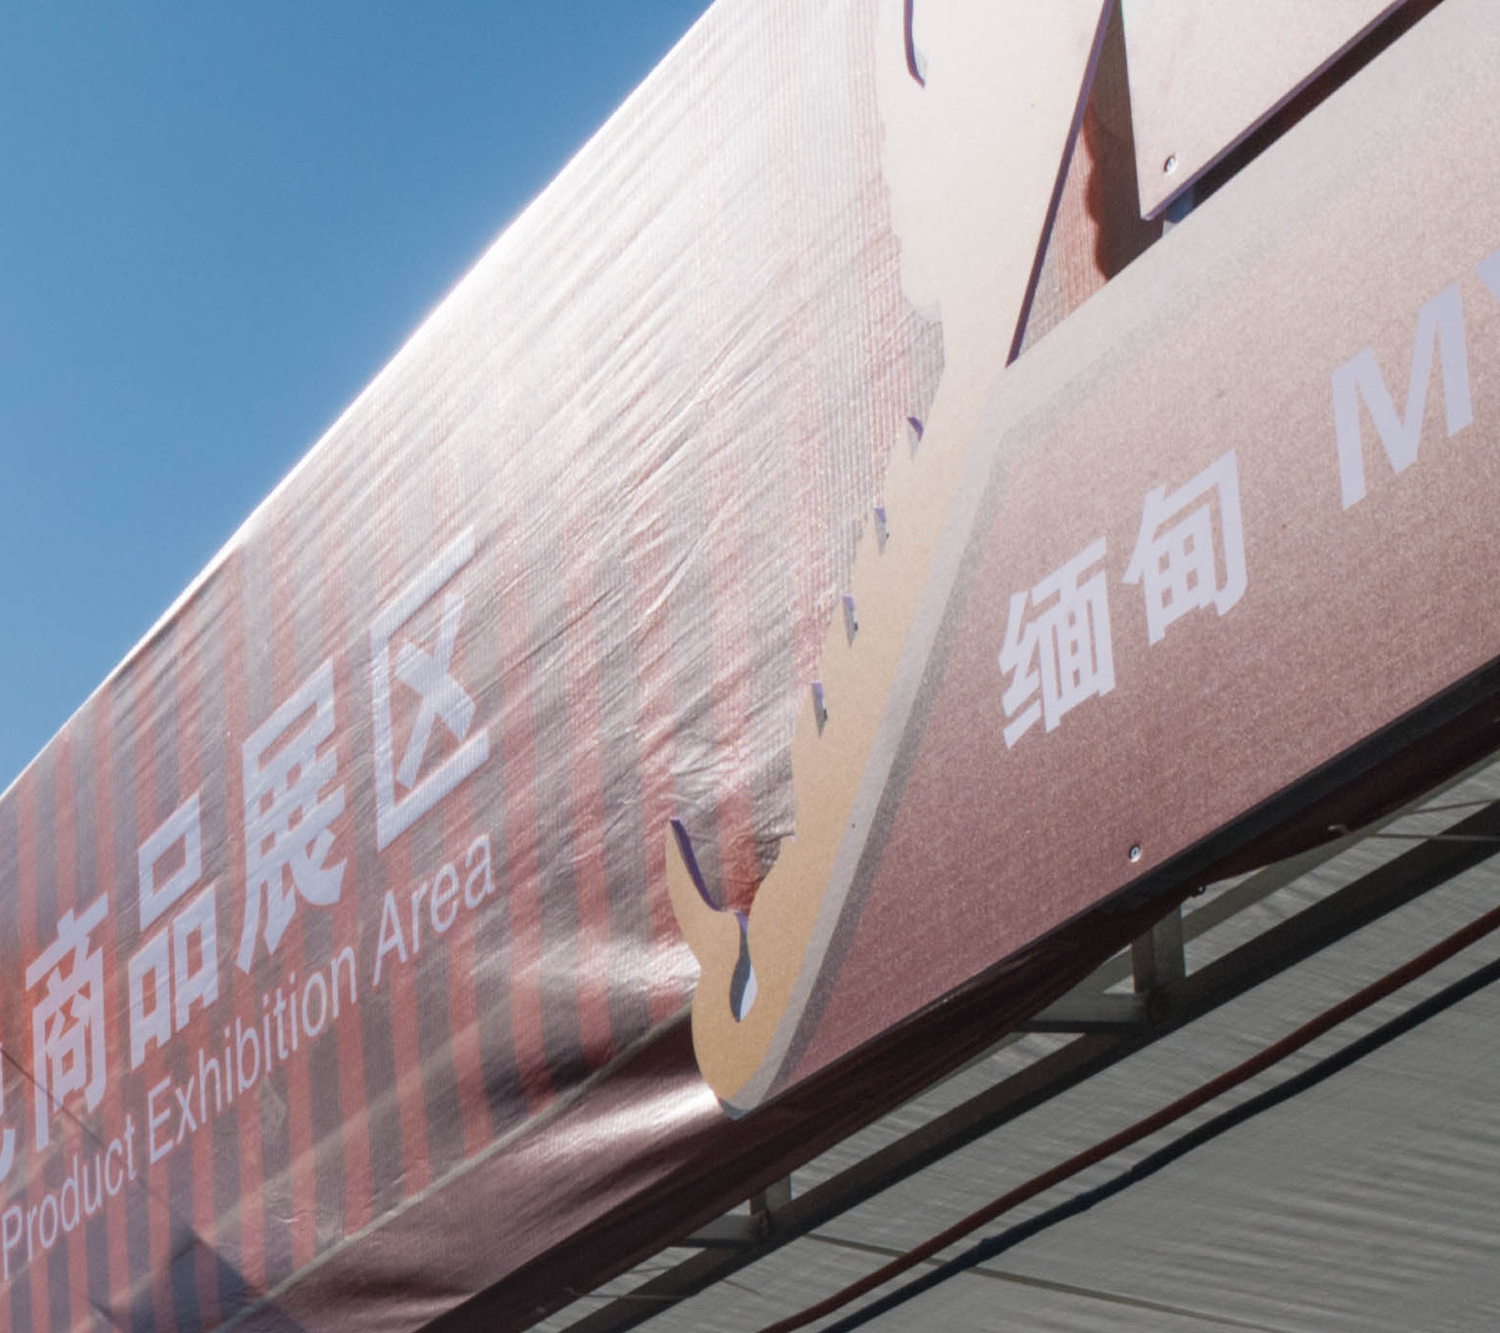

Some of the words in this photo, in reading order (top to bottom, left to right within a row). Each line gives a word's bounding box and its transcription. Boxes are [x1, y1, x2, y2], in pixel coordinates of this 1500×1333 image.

[1000, 451, 1248, 748] 缅甸
[1331, 250, 1500, 508] M
[3, 1112, 138, 1283] Product
[148, 945, 358, 1165] Exhibition
[372, 832, 495, 986] Area
